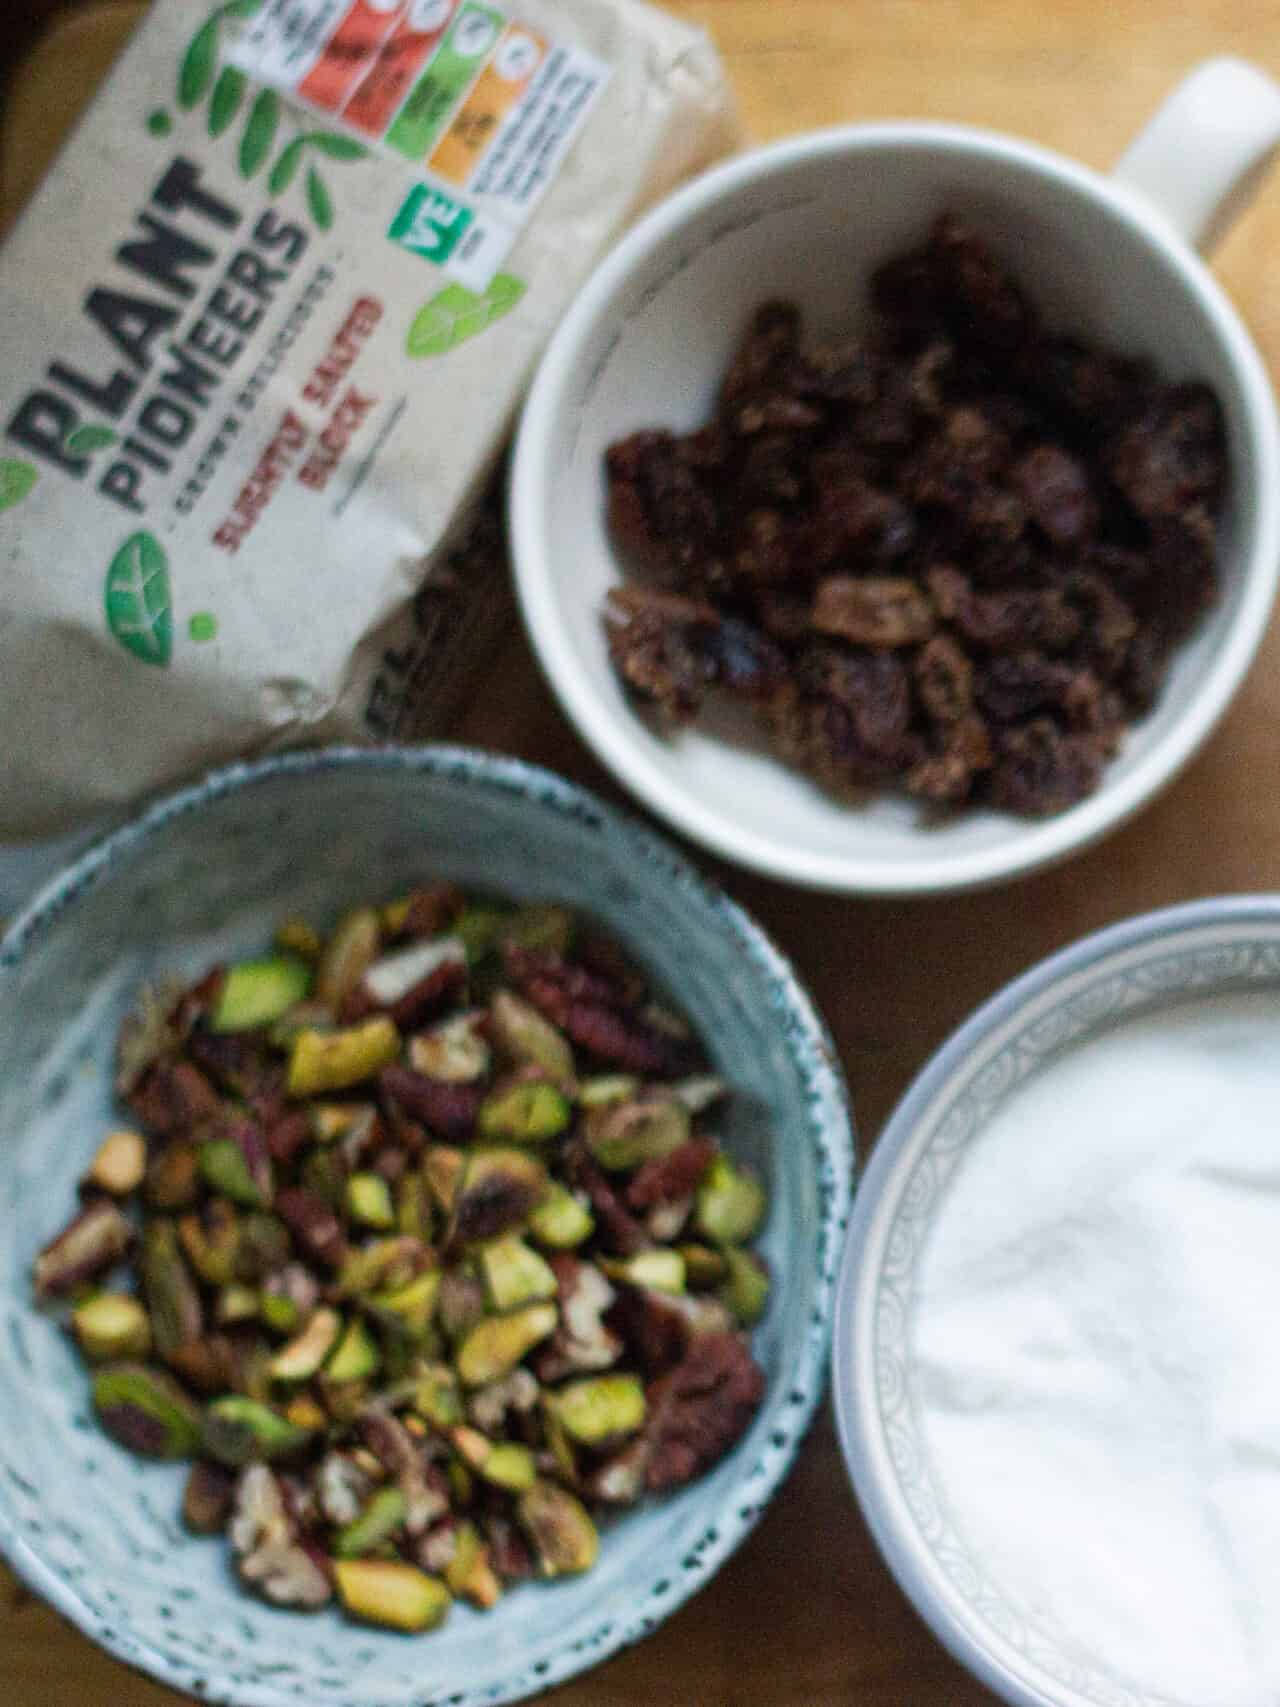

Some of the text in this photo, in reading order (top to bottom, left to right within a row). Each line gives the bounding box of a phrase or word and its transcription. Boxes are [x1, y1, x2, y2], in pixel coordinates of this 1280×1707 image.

[4, 154, 241, 479] PLANT
[97, 207, 307, 514] PIONEERS
[212, 409, 307, 554] SLIGHTLY
[302, 294, 385, 407] SALTED
[296, 384, 379, 493] BLOCK
